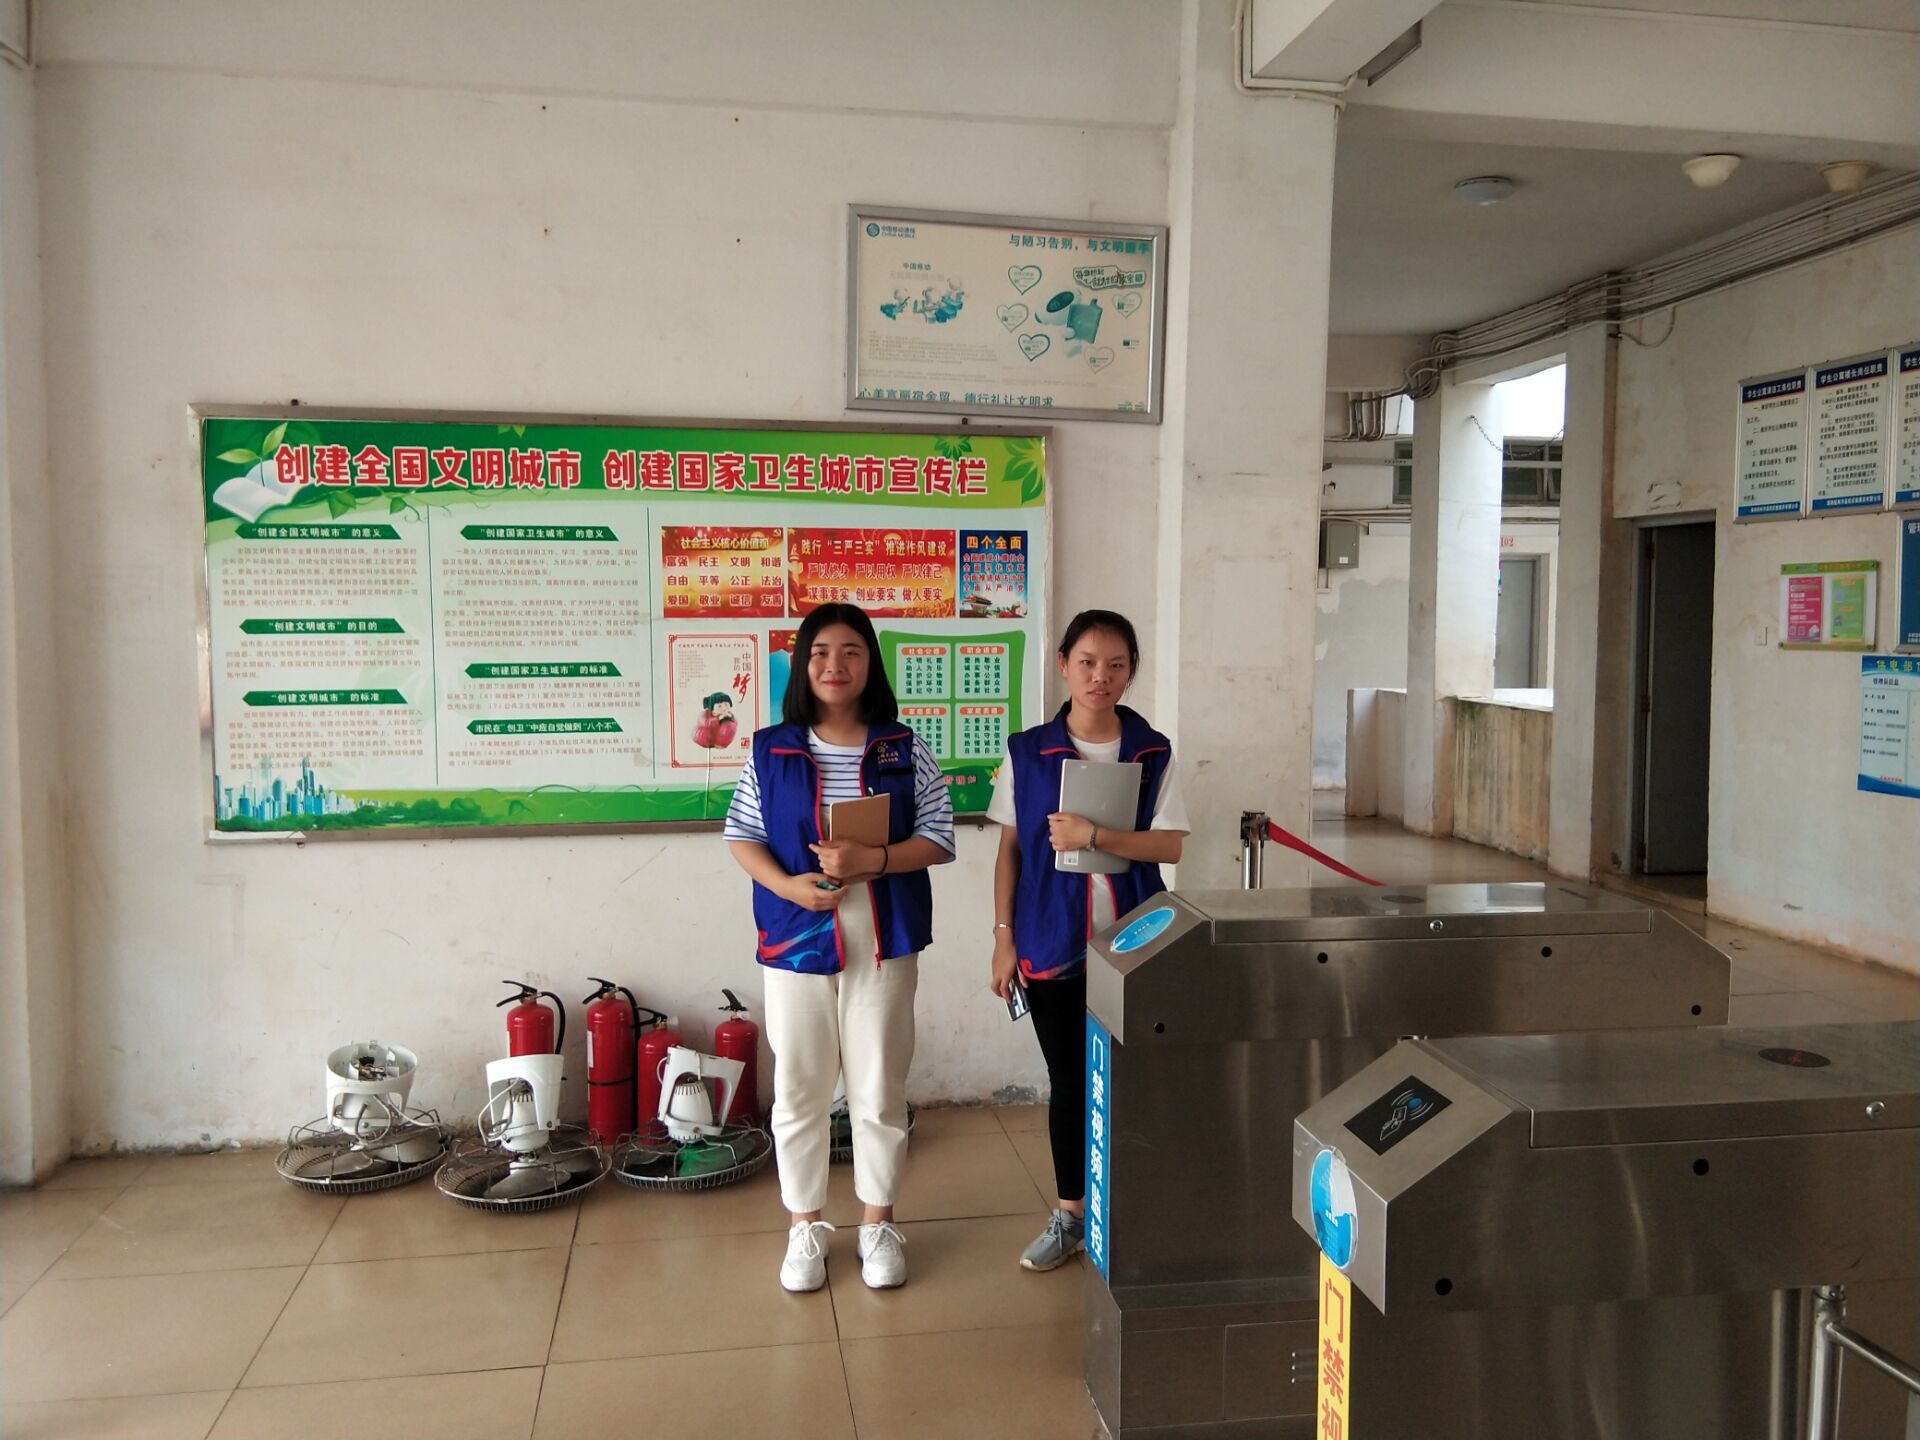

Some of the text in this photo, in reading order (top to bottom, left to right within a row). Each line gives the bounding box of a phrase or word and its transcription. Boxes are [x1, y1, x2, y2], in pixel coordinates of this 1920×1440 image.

[274, 443, 988, 497] 创建全国文明城市 创建国家卫生城市宣传栏
[681, 537, 769, 550] 社会主义核心价值观
[966, 535, 1022, 551] 四个全面
[666, 556, 782, 568] 富强 民主 文明 和谐
[808, 563, 942, 579] 严以修身 严以用权 严以律己
[666, 575, 782, 586] 自由 平等 公正 法治
[666, 595, 782, 606] 爱国 敬业 诚信 友善
[808, 587, 942, 602] 谋事要实 创业要实 做人要实
[1090, 1033, 1104, 1264] 门禁视频监控
